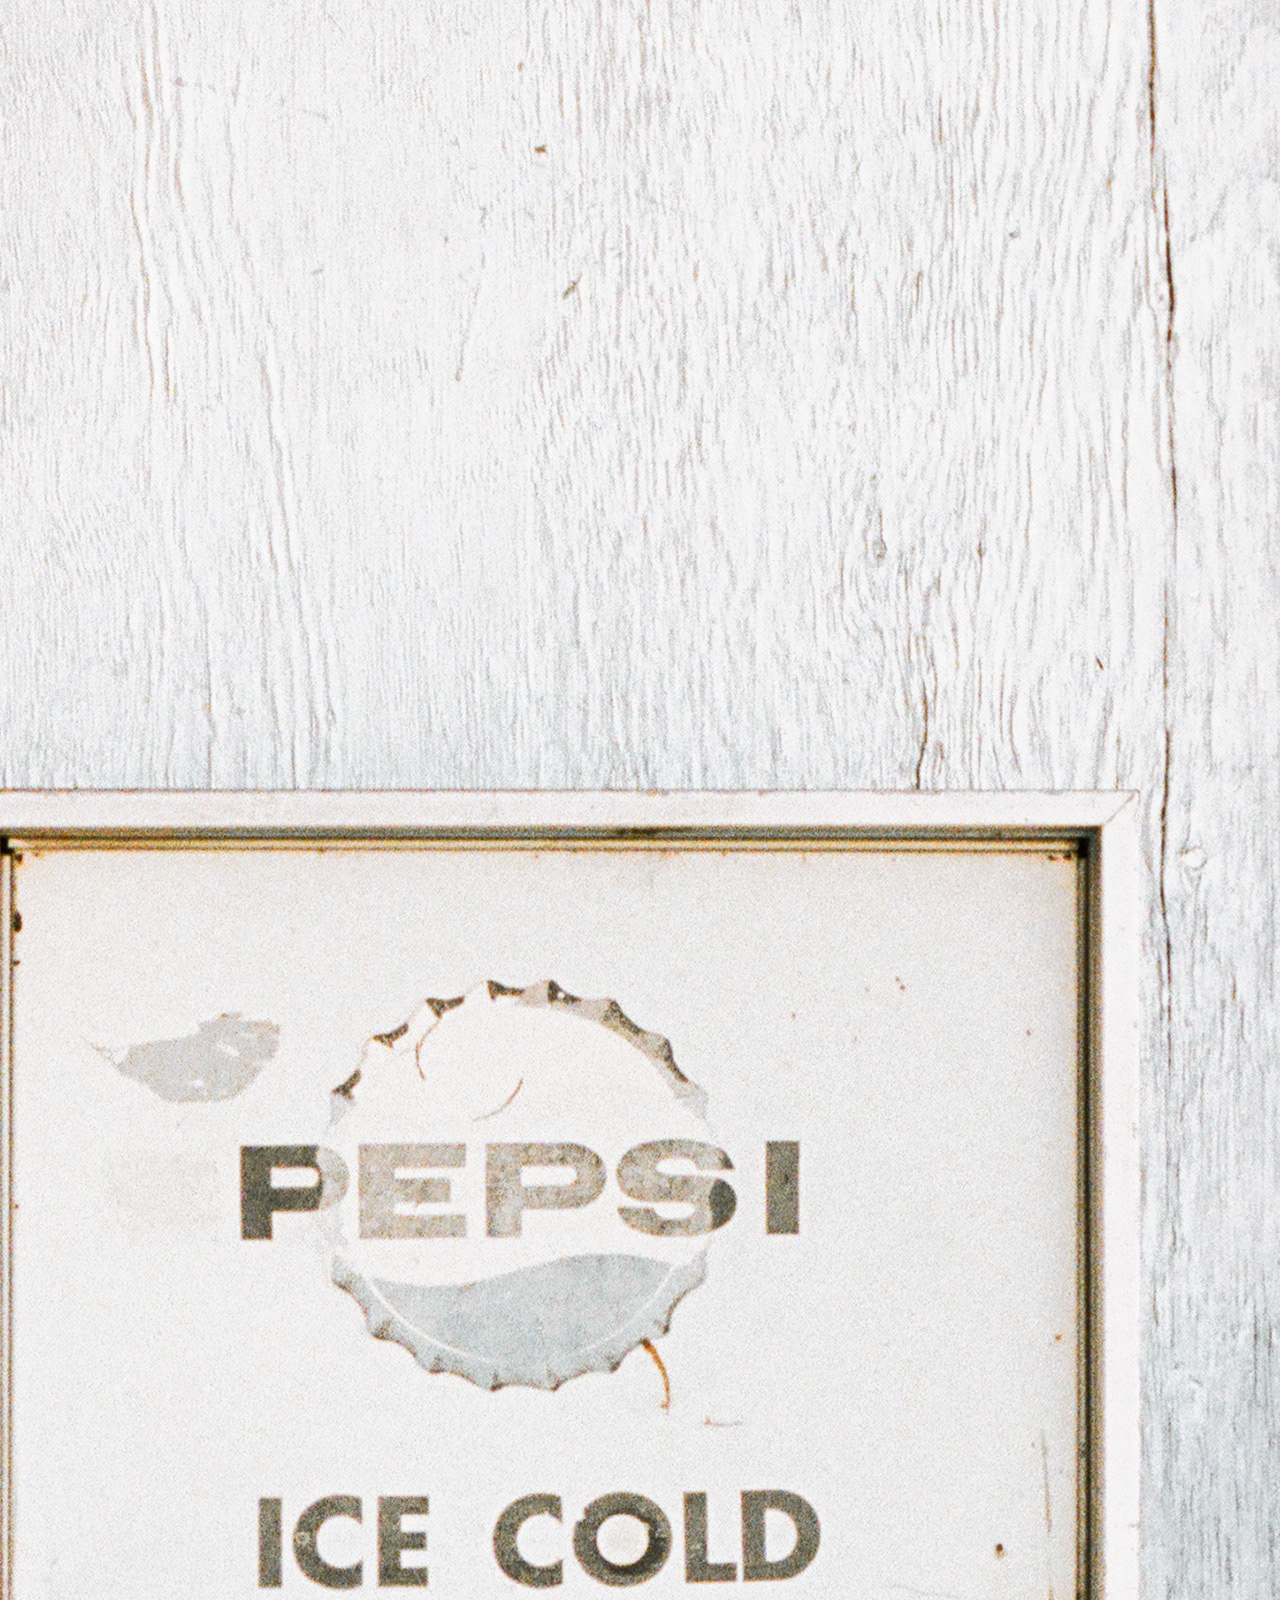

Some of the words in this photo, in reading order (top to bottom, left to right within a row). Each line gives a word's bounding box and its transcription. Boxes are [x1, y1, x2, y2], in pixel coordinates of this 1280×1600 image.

[240, 1138, 801, 1241] PEPSI
[256, 1494, 430, 1589] ICE
[492, 1489, 822, 1588] COLD
